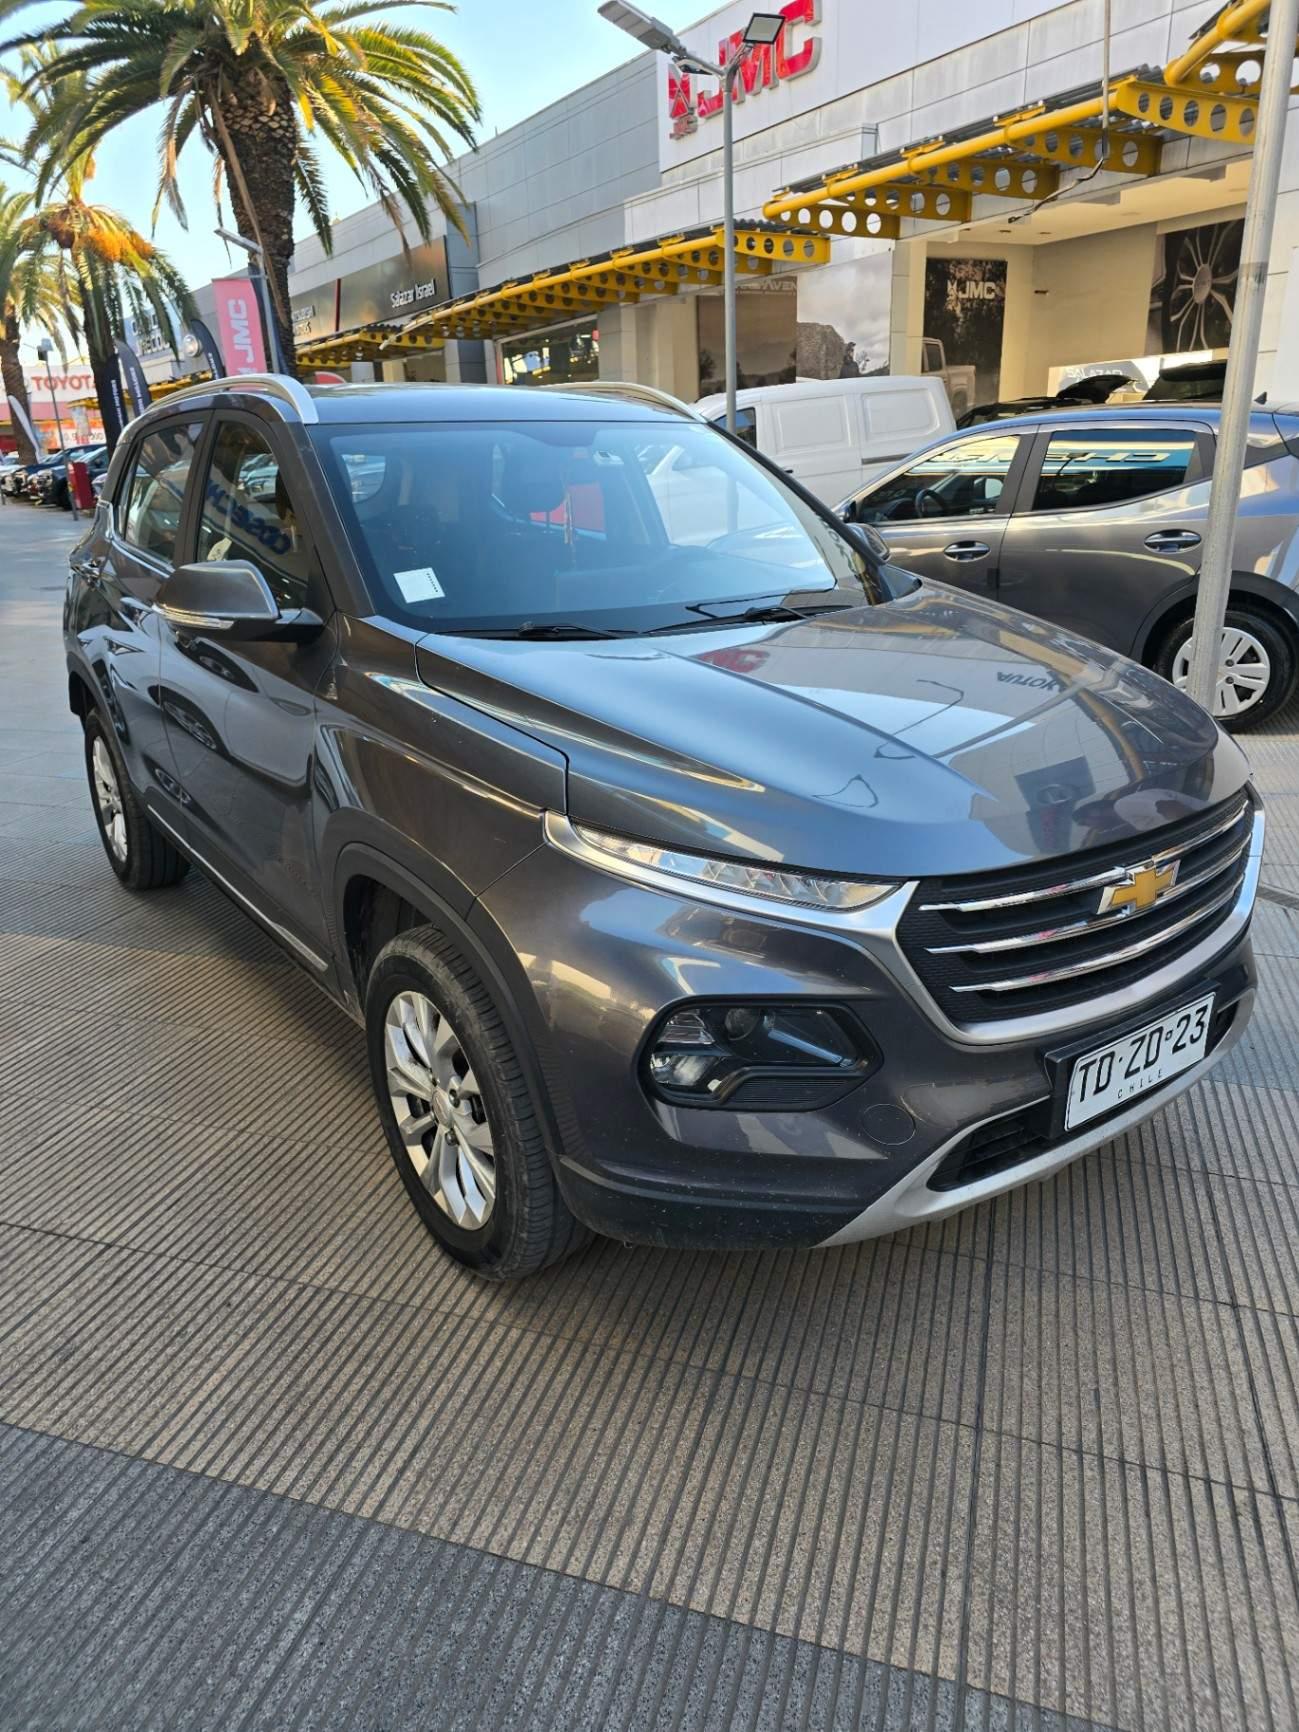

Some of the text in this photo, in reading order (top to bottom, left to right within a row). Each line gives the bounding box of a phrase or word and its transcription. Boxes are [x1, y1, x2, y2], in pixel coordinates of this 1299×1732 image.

[697, 0, 823, 118] JMC
[391, 278, 435, 308] Salazar Israel
[958, 280, 996, 300] JMC
[228, 299, 255, 363] JMC
[32, 375, 95, 391] TOYOT
[1117, 1068, 1163, 1099] CHILE
